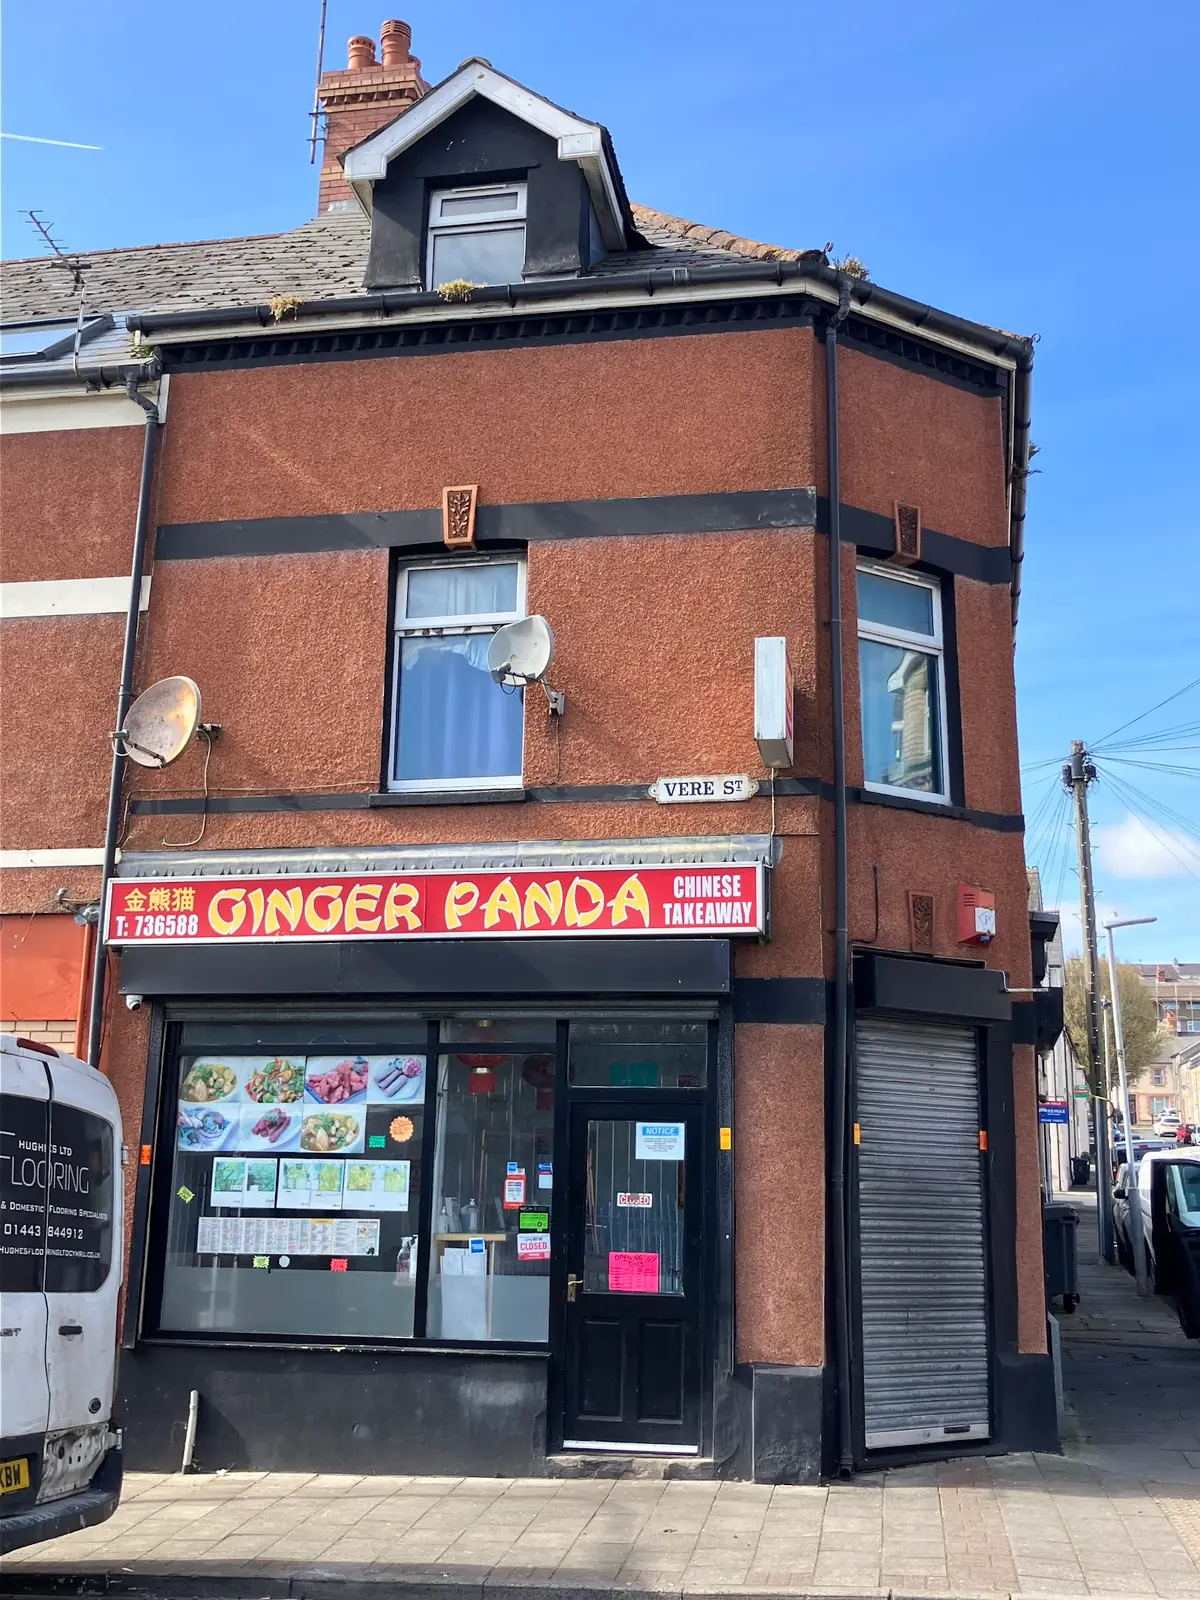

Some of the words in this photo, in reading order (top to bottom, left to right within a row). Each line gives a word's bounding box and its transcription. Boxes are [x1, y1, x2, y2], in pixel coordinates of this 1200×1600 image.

[664, 781, 715, 797] VERE
[673, 874, 741, 899] CHINESE
[123, 886, 196, 912] 金熊猫
[208, 881, 423, 935] GINGER
[445, 872, 650, 930] PANDA
[663, 901, 752, 926] TAKEAWAY
[115, 914, 132, 937] T:
[139, 913, 200, 937] 736588
[645, 1127, 676, 1135] NOTICE
[59, 1145, 73, 1157] LTD
[0, 1200, 7, 1210] &
[619, 1195, 650, 1205] CLOSED
[4, 1223, 41, 1236] 01443
[47, 1225, 83, 1240] 844912
[520, 1241, 548, 1251] CLOSED
